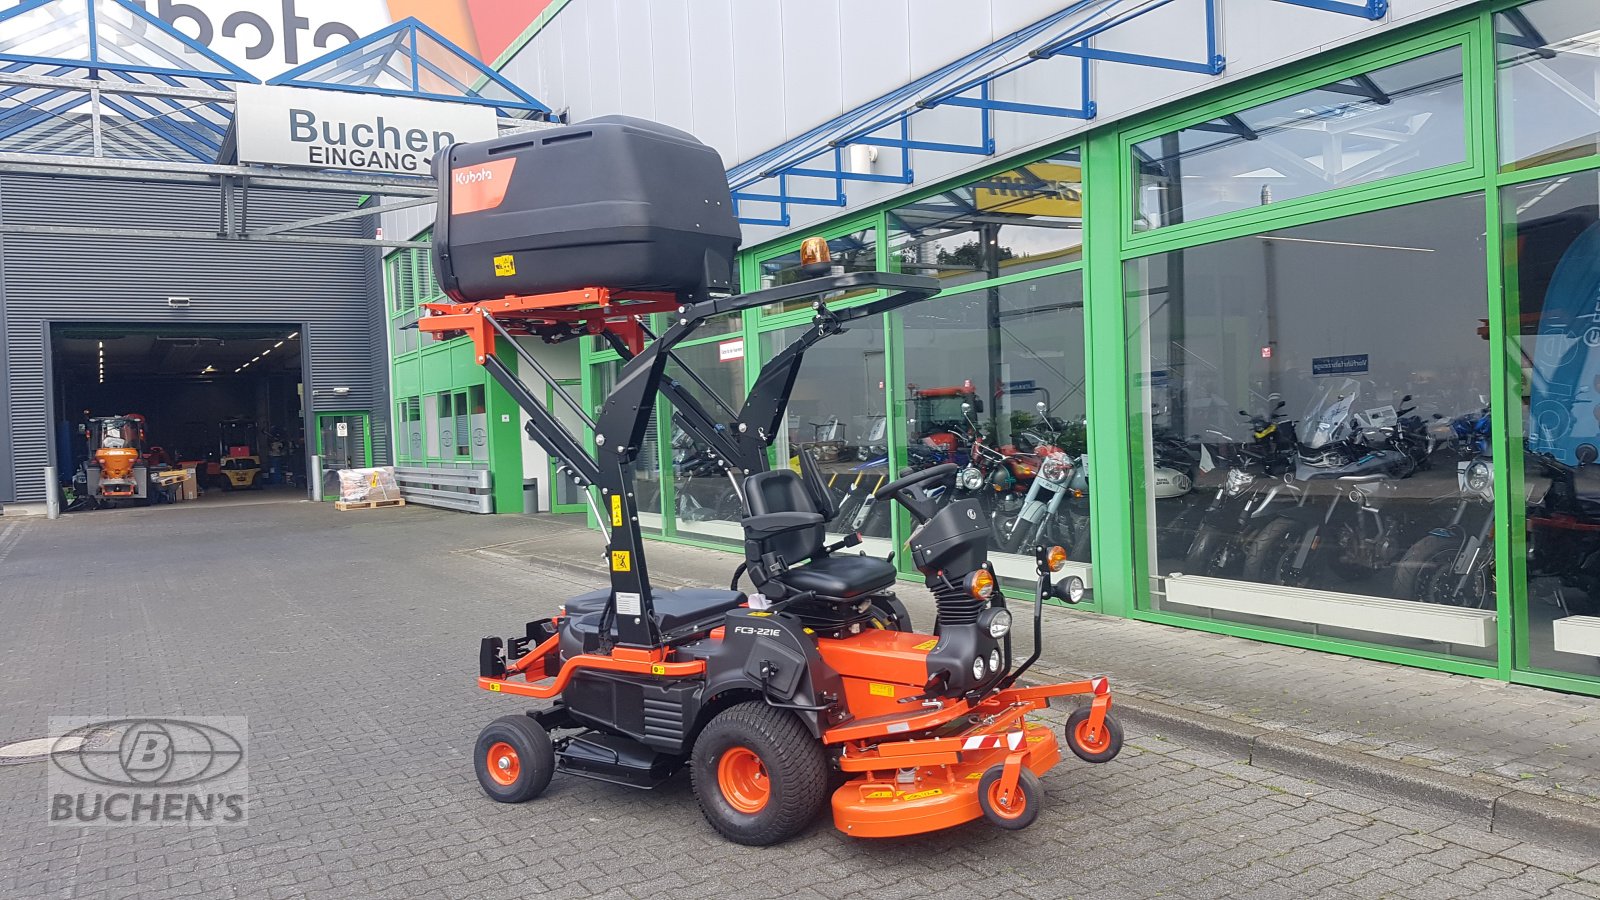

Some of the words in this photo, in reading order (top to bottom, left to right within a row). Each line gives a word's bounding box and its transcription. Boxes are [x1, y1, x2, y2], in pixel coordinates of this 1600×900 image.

[309, 145, 417, 171] EINGANG
[455, 168, 492, 184] Kubota
[734, 626, 781, 637] FC3-221E
